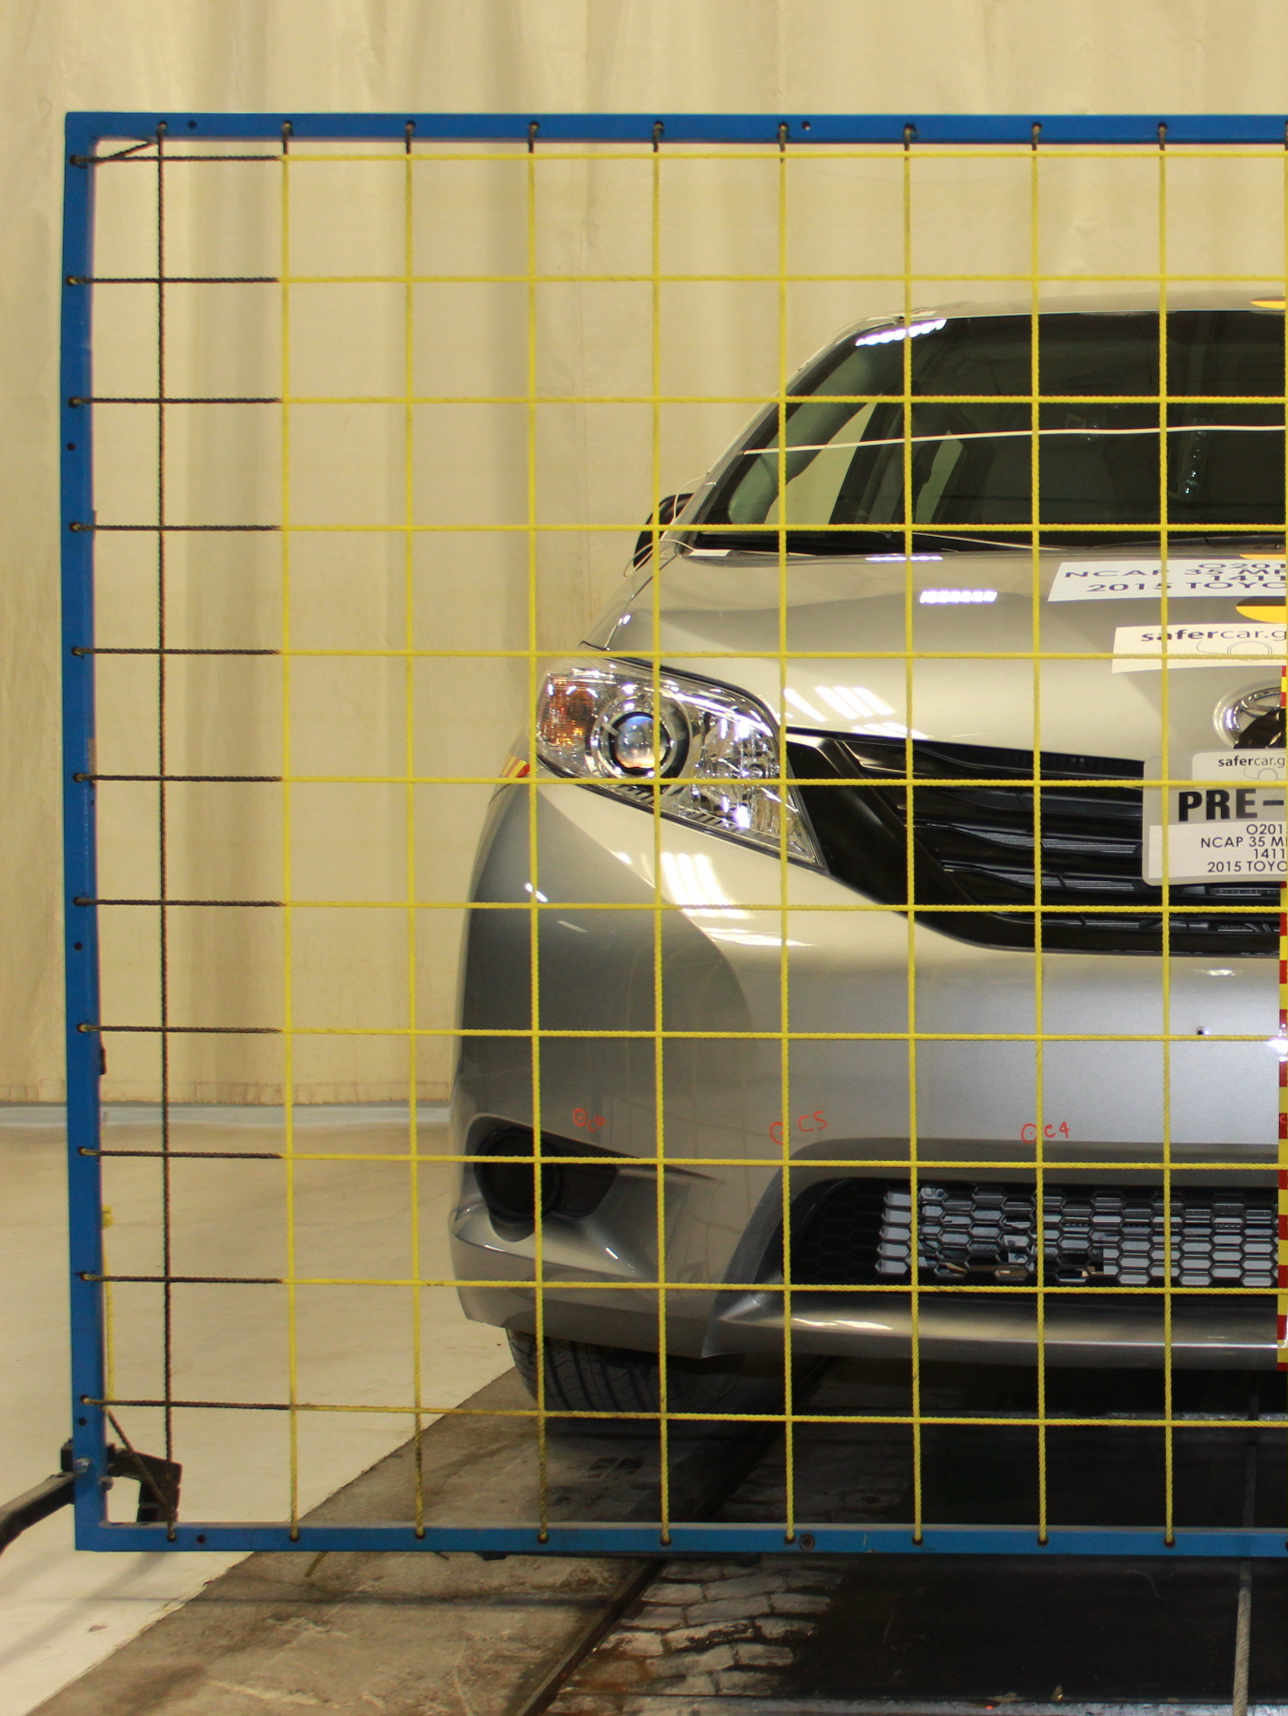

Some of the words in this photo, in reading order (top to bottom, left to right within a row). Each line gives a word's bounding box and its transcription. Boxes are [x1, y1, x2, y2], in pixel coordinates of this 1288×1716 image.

[1183, 568, 1224, 576] 35
[1200, 837, 1244, 848] NCAP
[1248, 836, 1266, 848] 35
[1207, 861, 1242, 873] 2015
